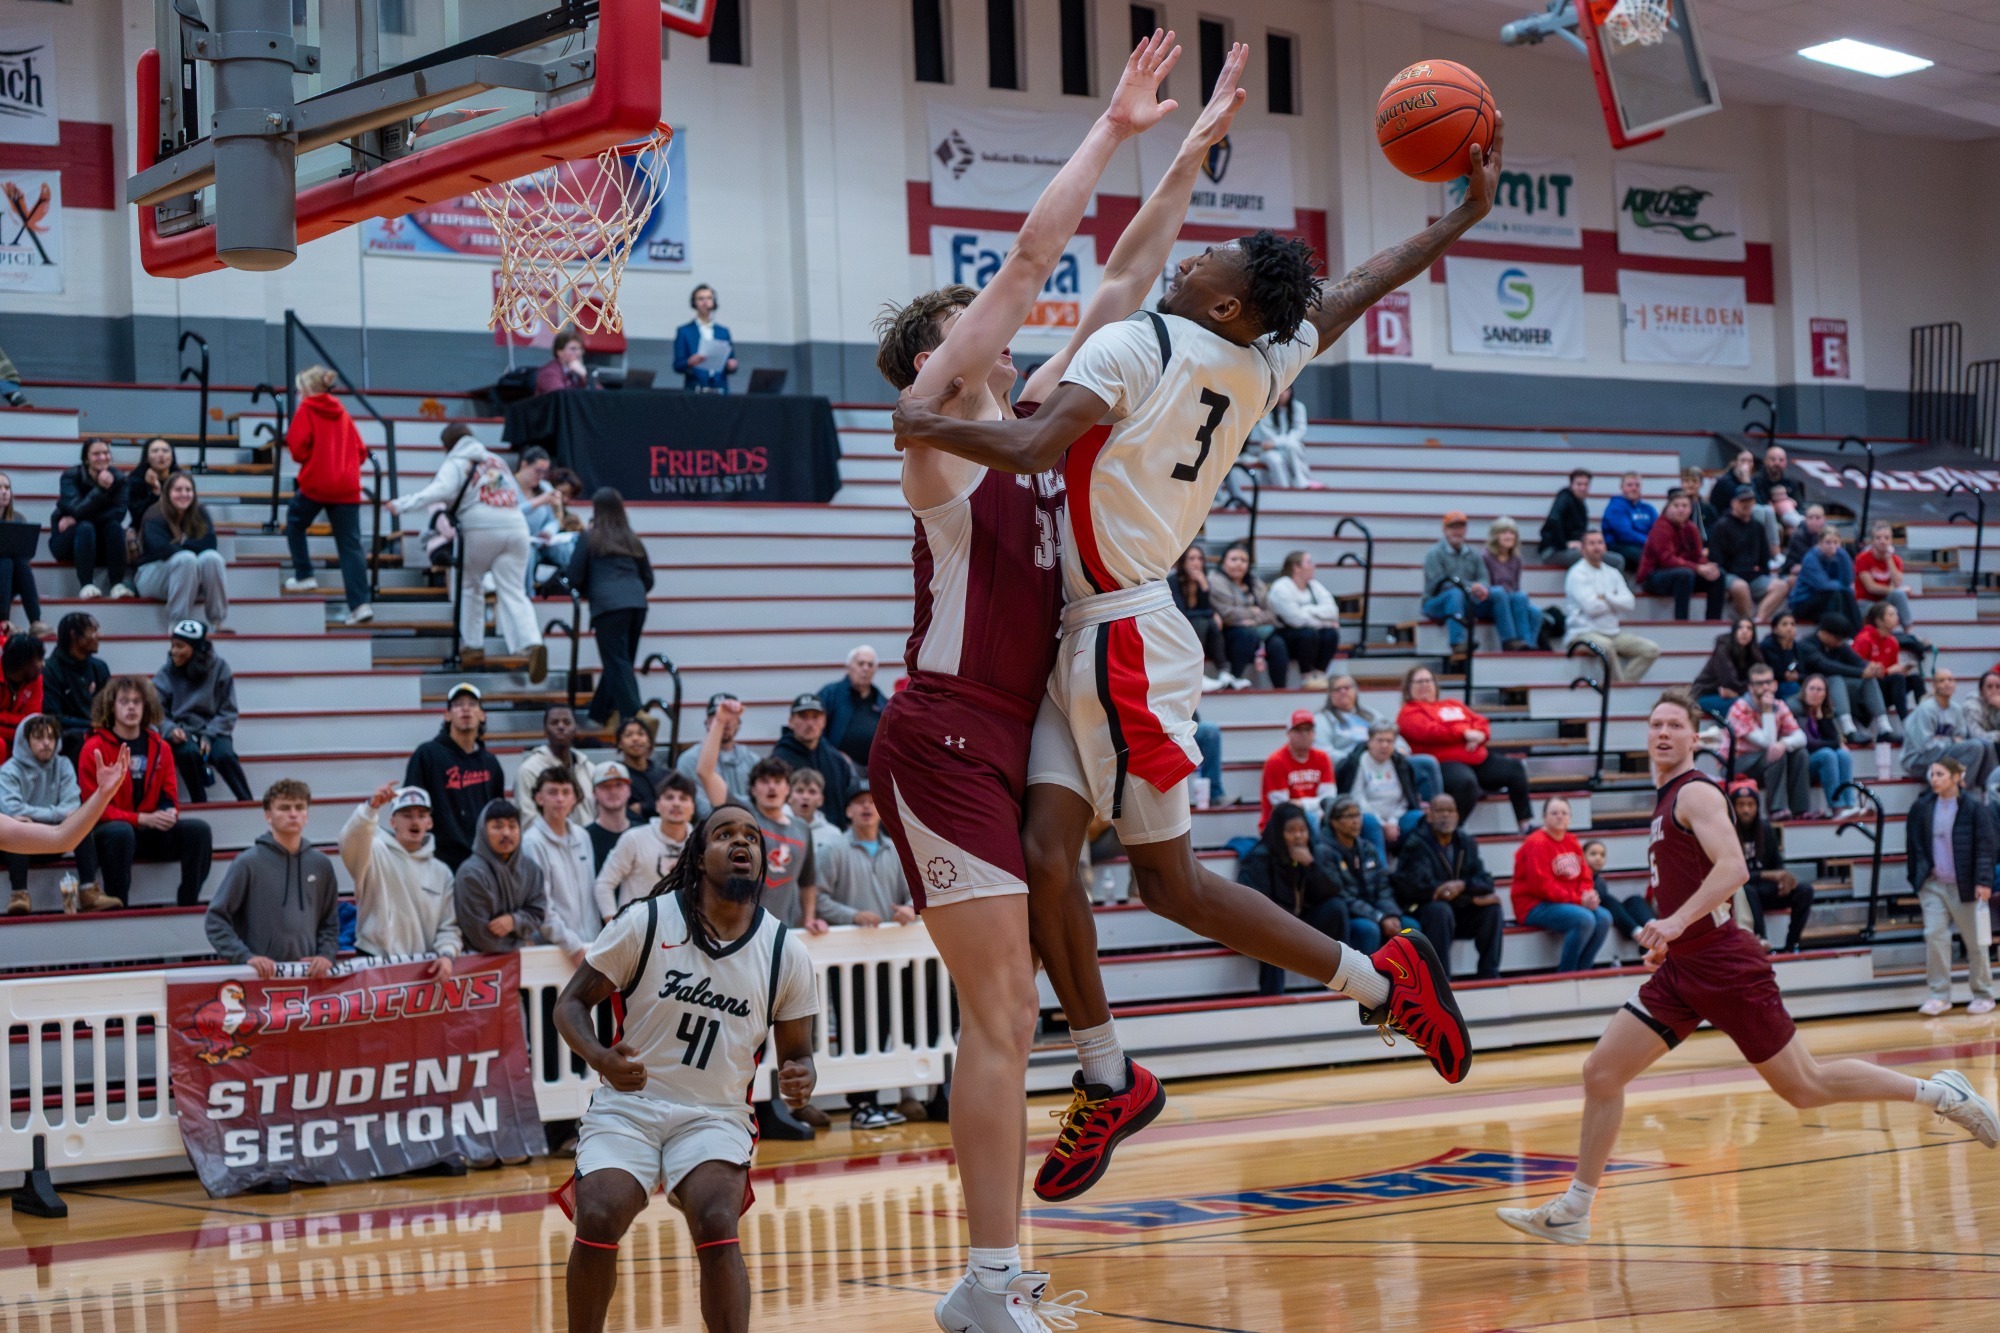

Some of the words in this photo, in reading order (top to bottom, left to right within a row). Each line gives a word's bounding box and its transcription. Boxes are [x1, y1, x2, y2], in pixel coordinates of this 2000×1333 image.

[1221, 192, 1264, 210] SPORTS
[1378, 311, 1401, 348] D
[1652, 304, 1744, 326] SHELDEN
[1823, 337, 1841, 371] E
[1171, 387, 1230, 482] 3
[650, 446, 768, 477] FRIENDS
[650, 474, 767, 494] UNIVERSITY
[259, 970, 502, 1034] FALCONS
[659, 970, 750, 1017] Falcons
[676, 1012, 720, 1071] 41
[206, 1049, 499, 1120] STUDENT
[223, 1096, 498, 1168] SECTION
